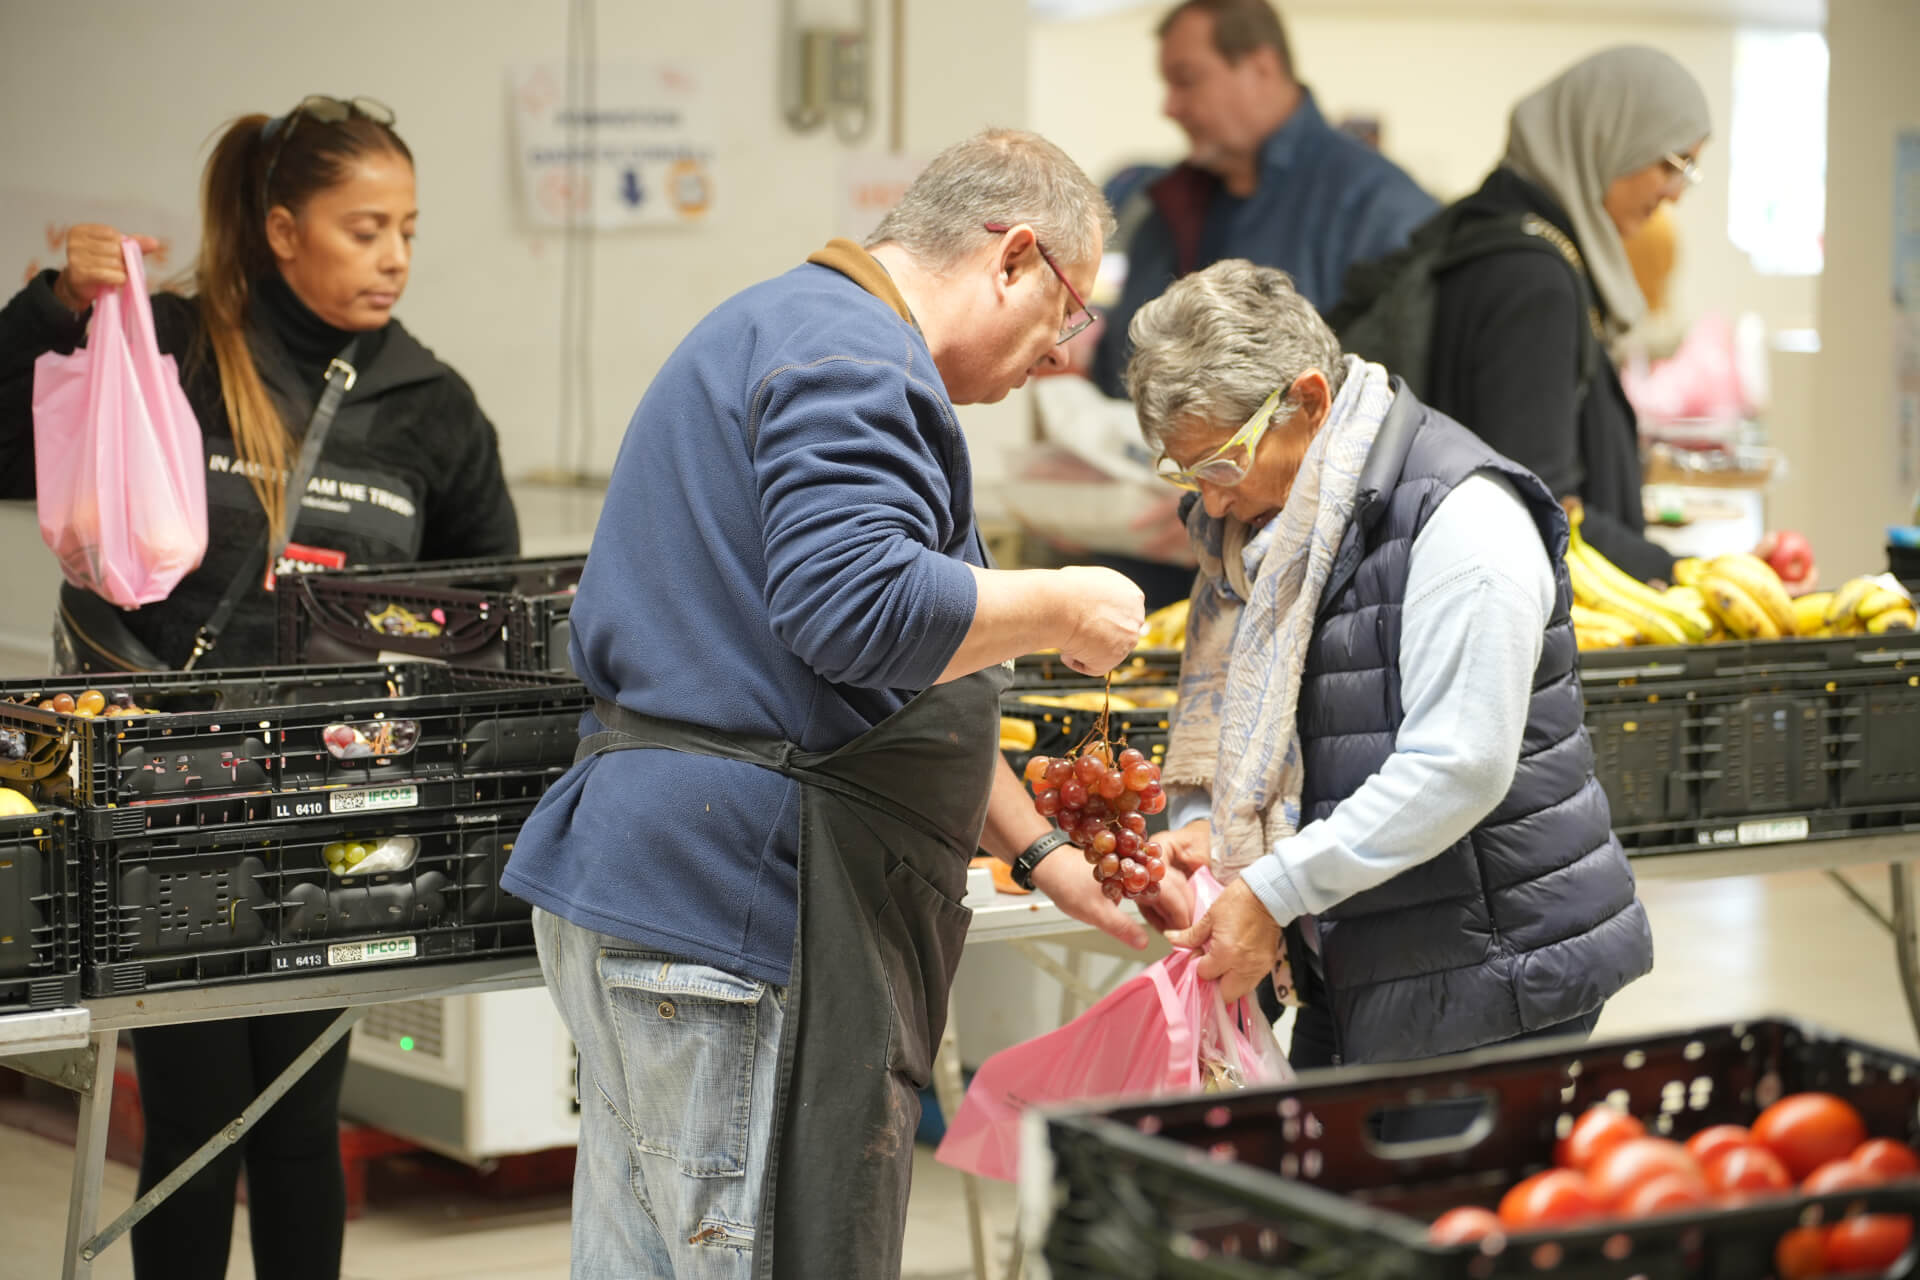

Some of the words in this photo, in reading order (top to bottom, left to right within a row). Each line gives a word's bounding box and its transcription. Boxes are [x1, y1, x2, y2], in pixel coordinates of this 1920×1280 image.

[209, 455, 230, 472] IN
[339, 481, 367, 502] WE
[276, 805, 291, 817] LL
[295, 803, 323, 816] 6410
[368, 788, 399, 802] IFCO
[276, 958, 289, 969] LL
[295, 955, 322, 967] 6413
[366, 940, 397, 955] IFCO
